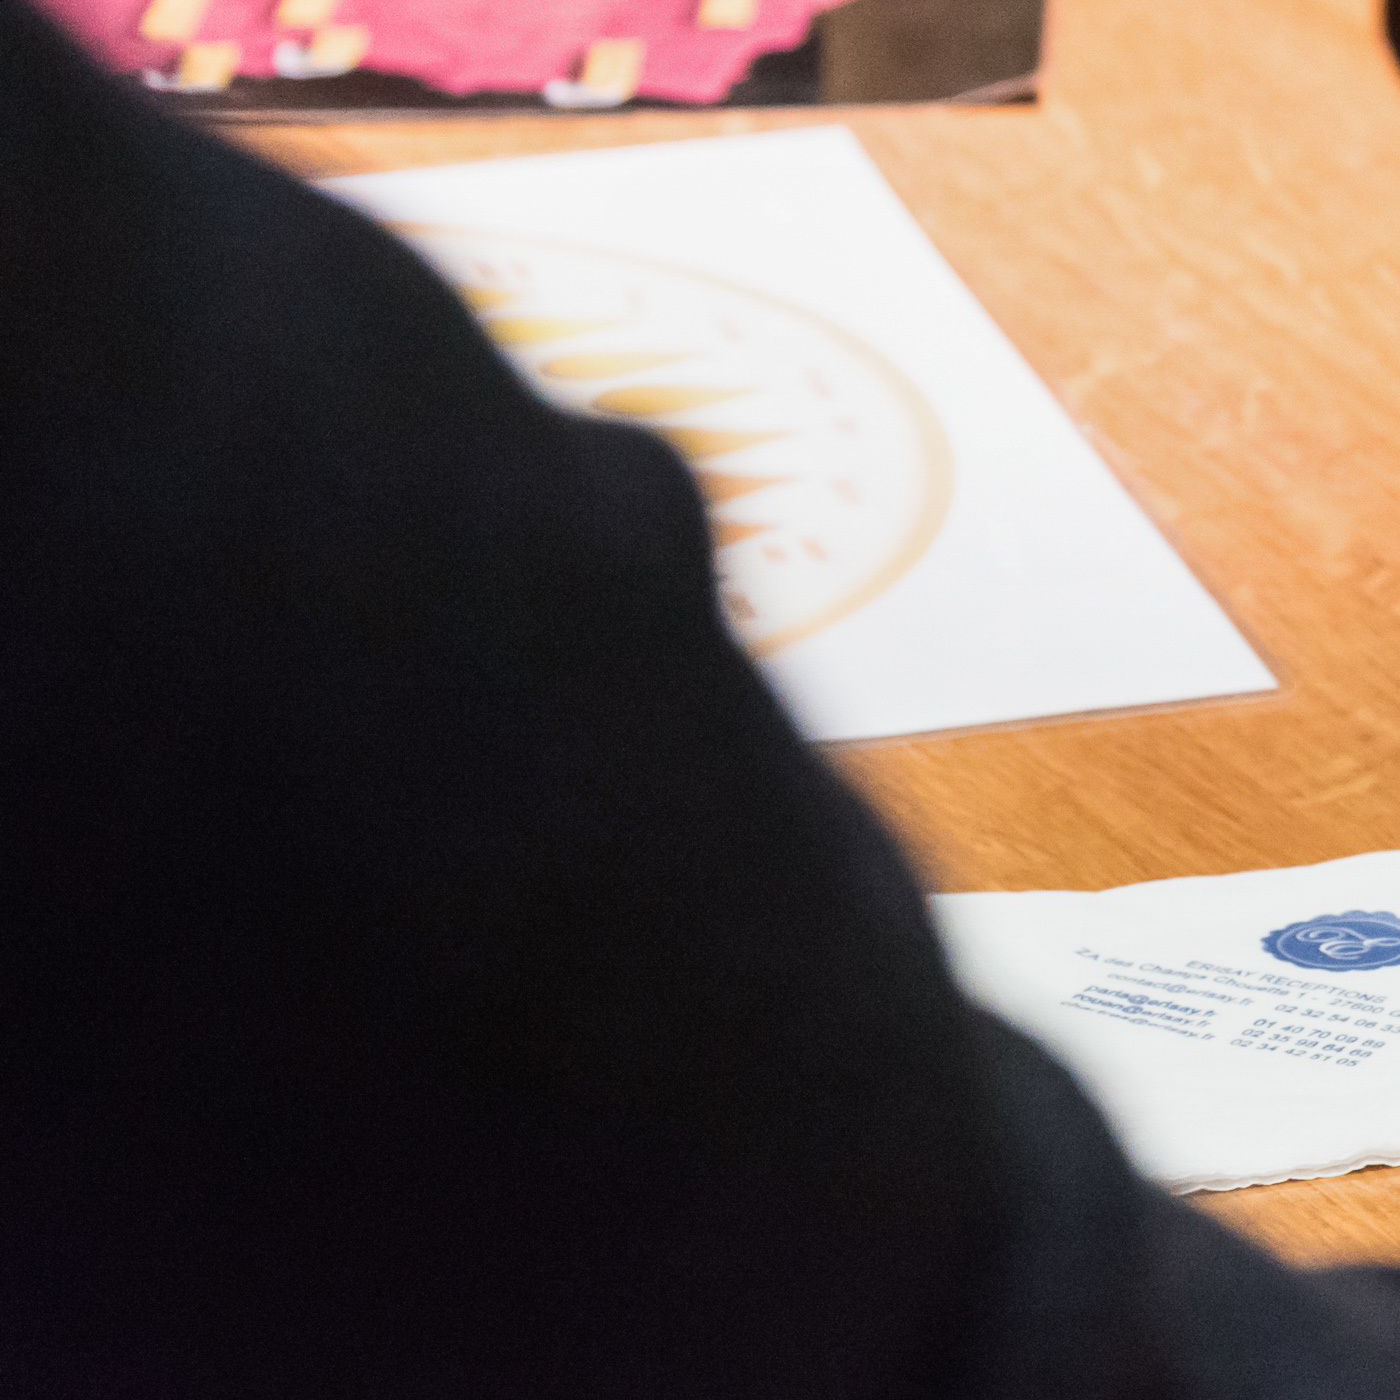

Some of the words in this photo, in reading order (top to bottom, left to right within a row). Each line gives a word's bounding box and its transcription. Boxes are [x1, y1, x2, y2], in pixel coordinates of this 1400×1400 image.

[1074, 947, 1099, 961] ZA
[1104, 958, 1133, 967] des
[1139, 963, 1207, 979] Champs
[1213, 976, 1289, 996] Chouette
[1329, 998, 1385, 1014] 27600
[1107, 973, 1254, 1005] contact@erisay.fr
[1186, 961, 1257, 976] ERISAY
[1259, 973, 1388, 1003] RECEPTIONS
[1274, 1004, 1298, 1013] 02
[1300, 1008, 1325, 1018] 32
[1241, 1029, 1265, 1038] 02
[1253, 1018, 1277, 1029] 01
[1281, 1025, 1305, 1034] 40
[1307, 1029, 1331, 1039] 70
[1230, 1038, 1254, 1047] 02
